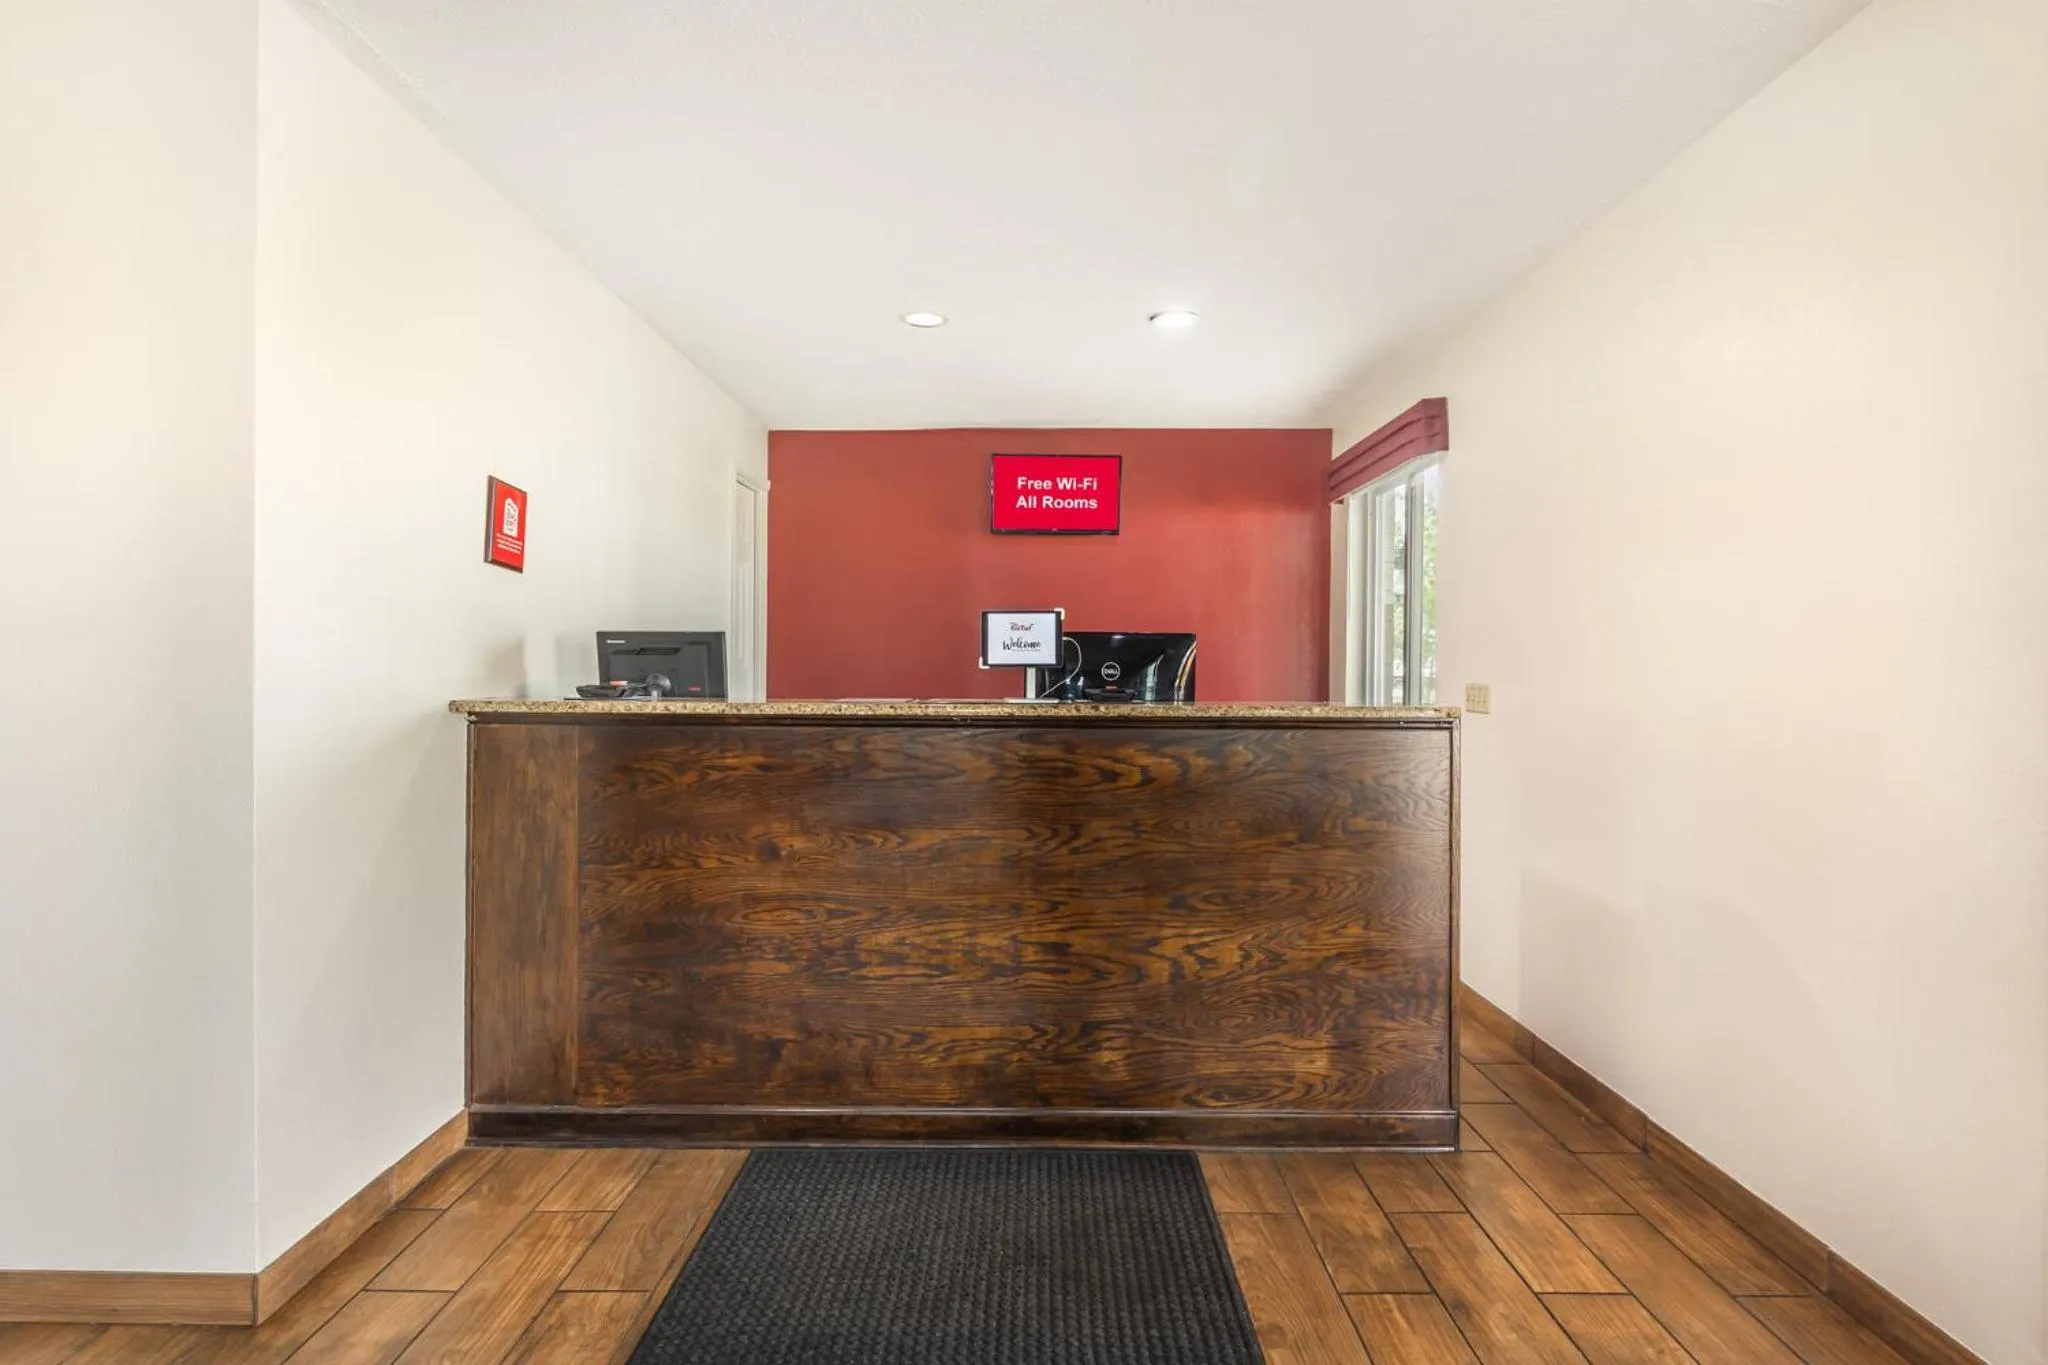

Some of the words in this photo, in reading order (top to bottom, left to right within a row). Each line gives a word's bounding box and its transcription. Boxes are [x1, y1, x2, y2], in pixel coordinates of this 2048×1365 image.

[1017, 477, 1052, 490] Free
[1056, 477, 1098, 490] Wi-Fi
[1016, 495, 1037, 509] All
[1042, 496, 1098, 509] Rooms
[1002, 636, 1041, 650] Welcome
